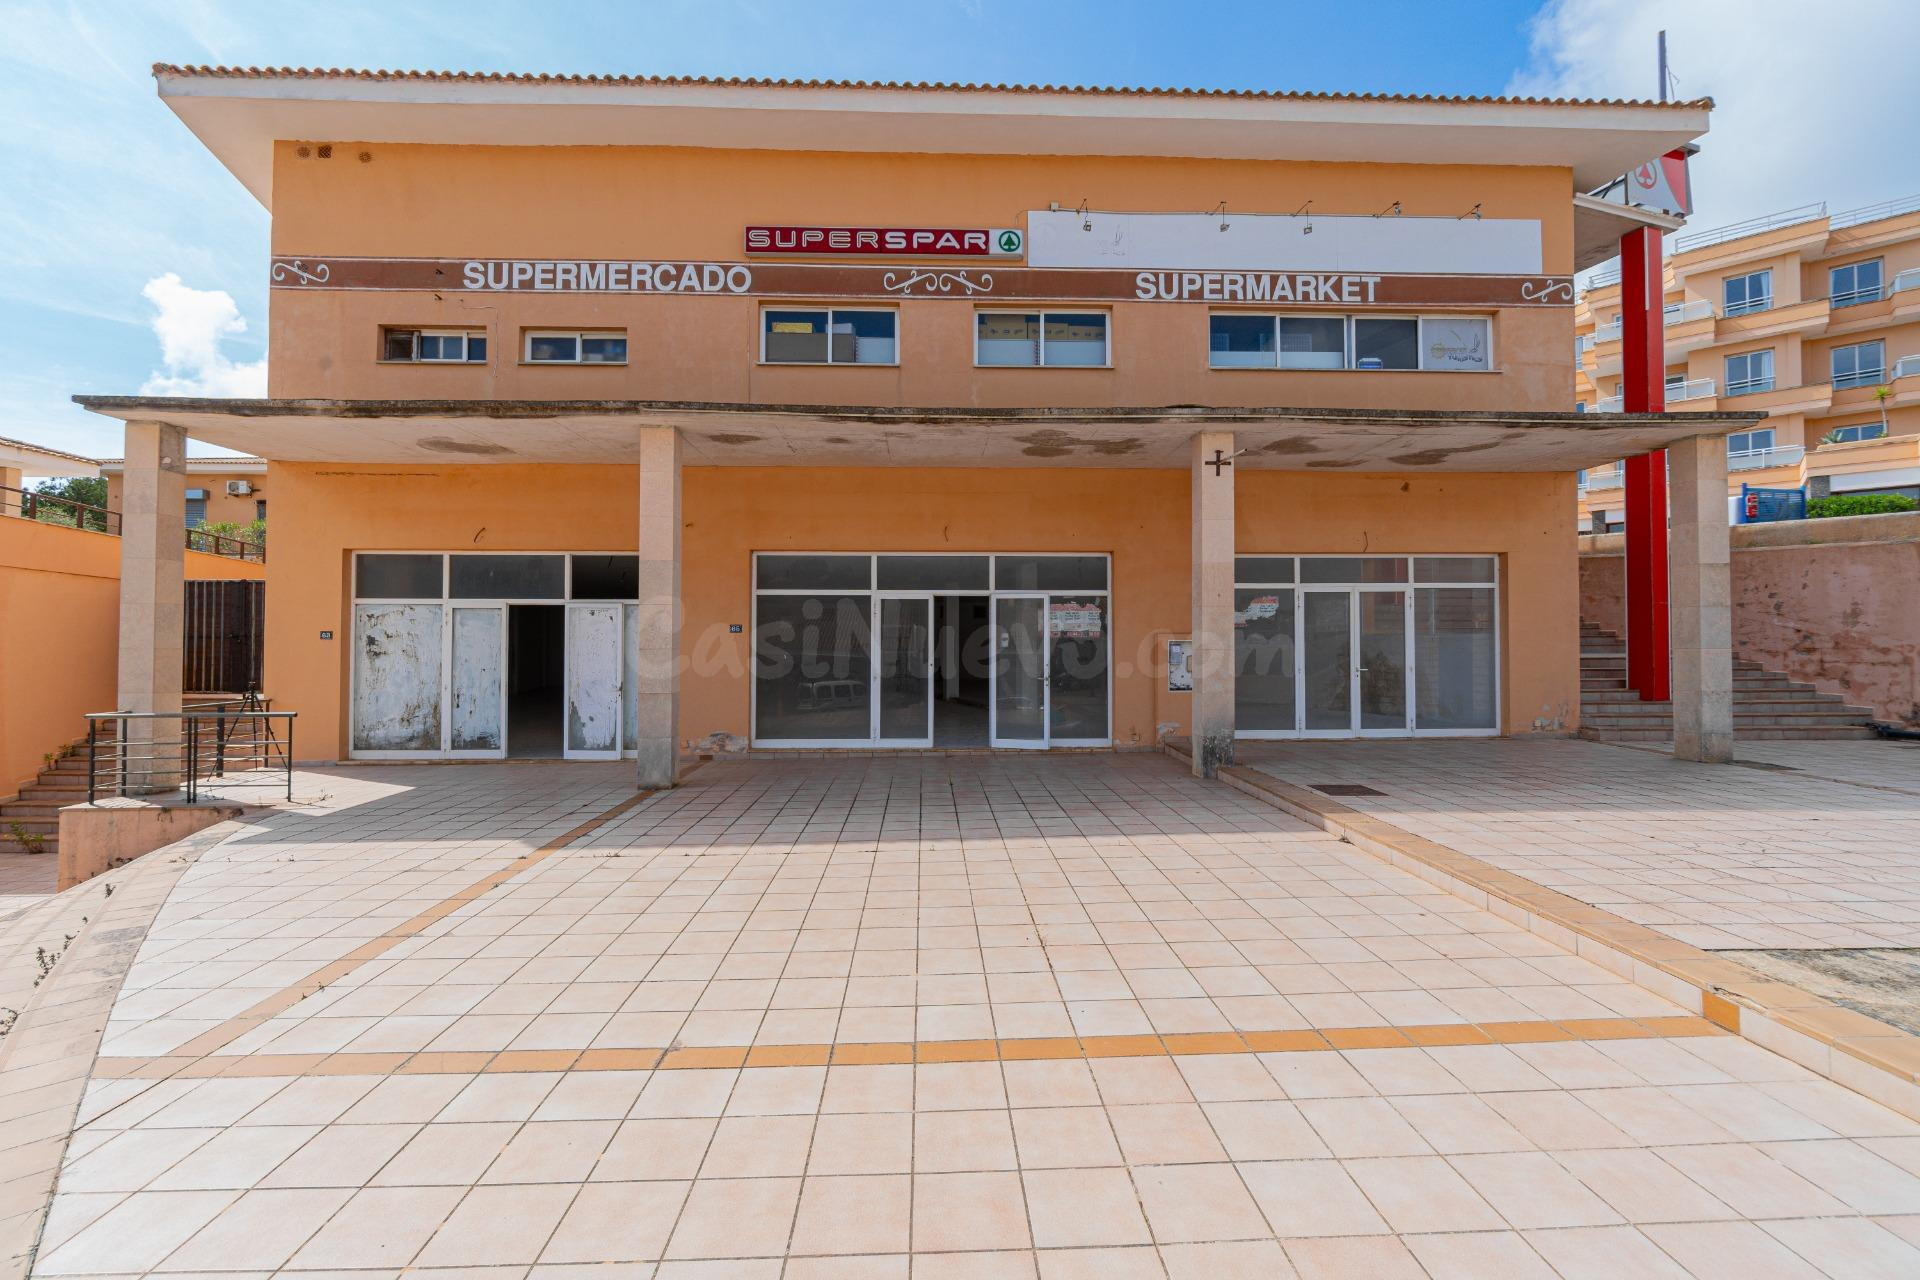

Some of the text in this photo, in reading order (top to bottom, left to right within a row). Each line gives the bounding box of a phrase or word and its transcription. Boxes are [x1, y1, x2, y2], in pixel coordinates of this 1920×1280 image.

[749, 230, 987, 250] SUPERSPAR
[463, 262, 752, 292] SUPERMERCADO
[1135, 272, 1381, 302] SUPERMARKET
